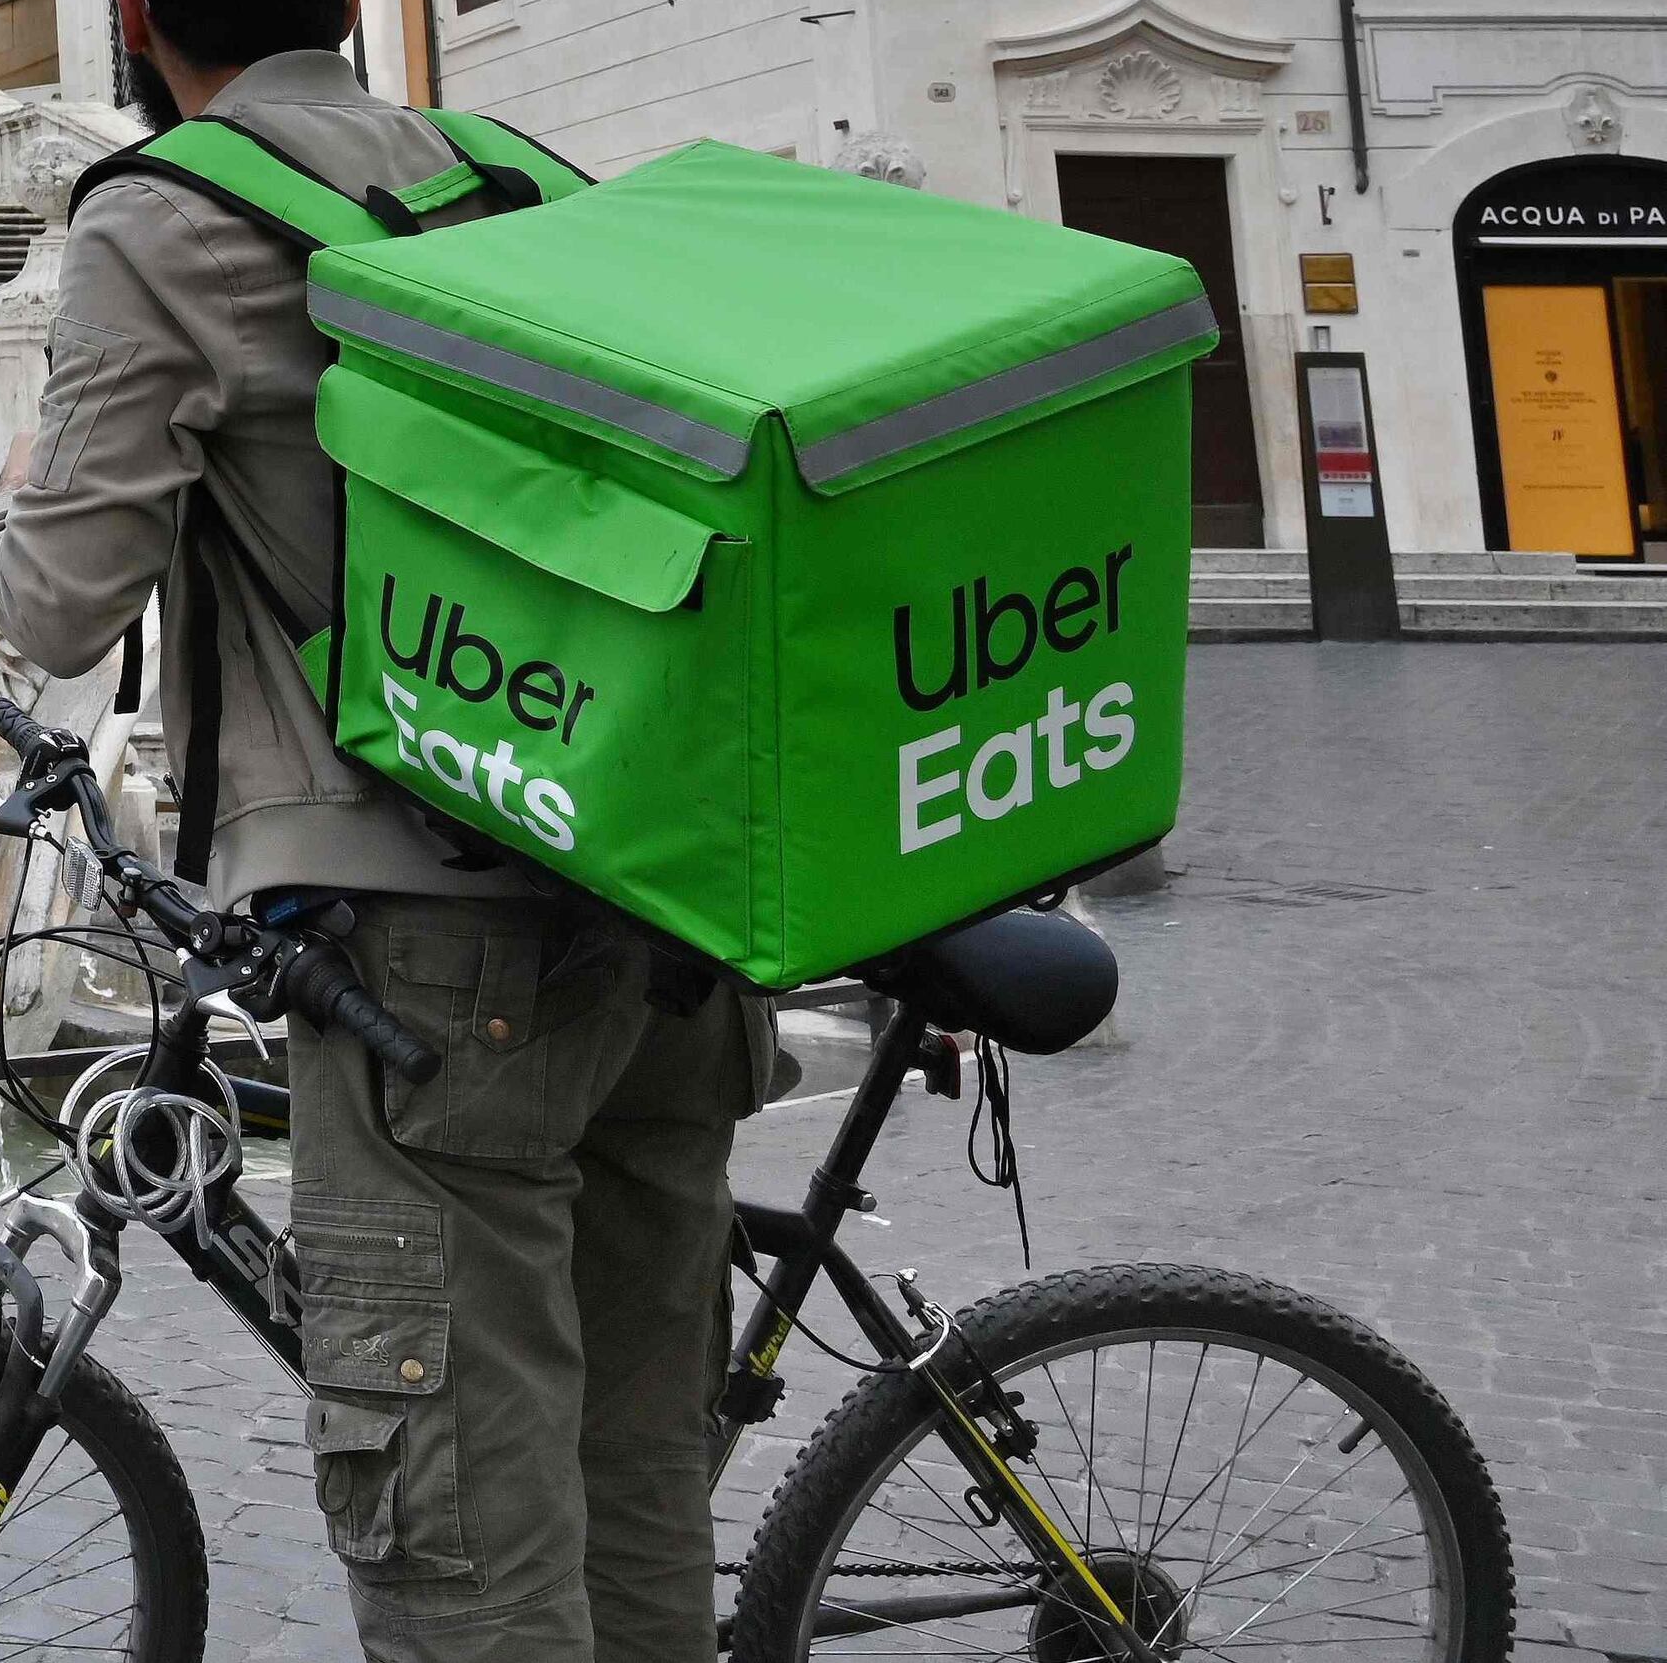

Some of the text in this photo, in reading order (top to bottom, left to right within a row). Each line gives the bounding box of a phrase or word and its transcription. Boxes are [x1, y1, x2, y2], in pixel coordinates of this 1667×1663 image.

[1480, 206, 1667, 227] ACQUA DI PA
[379, 573, 595, 746] Uber
[894, 543, 1134, 713] Uber
[382, 671, 578, 853] Eats
[898, 676, 1137, 856] Eats
